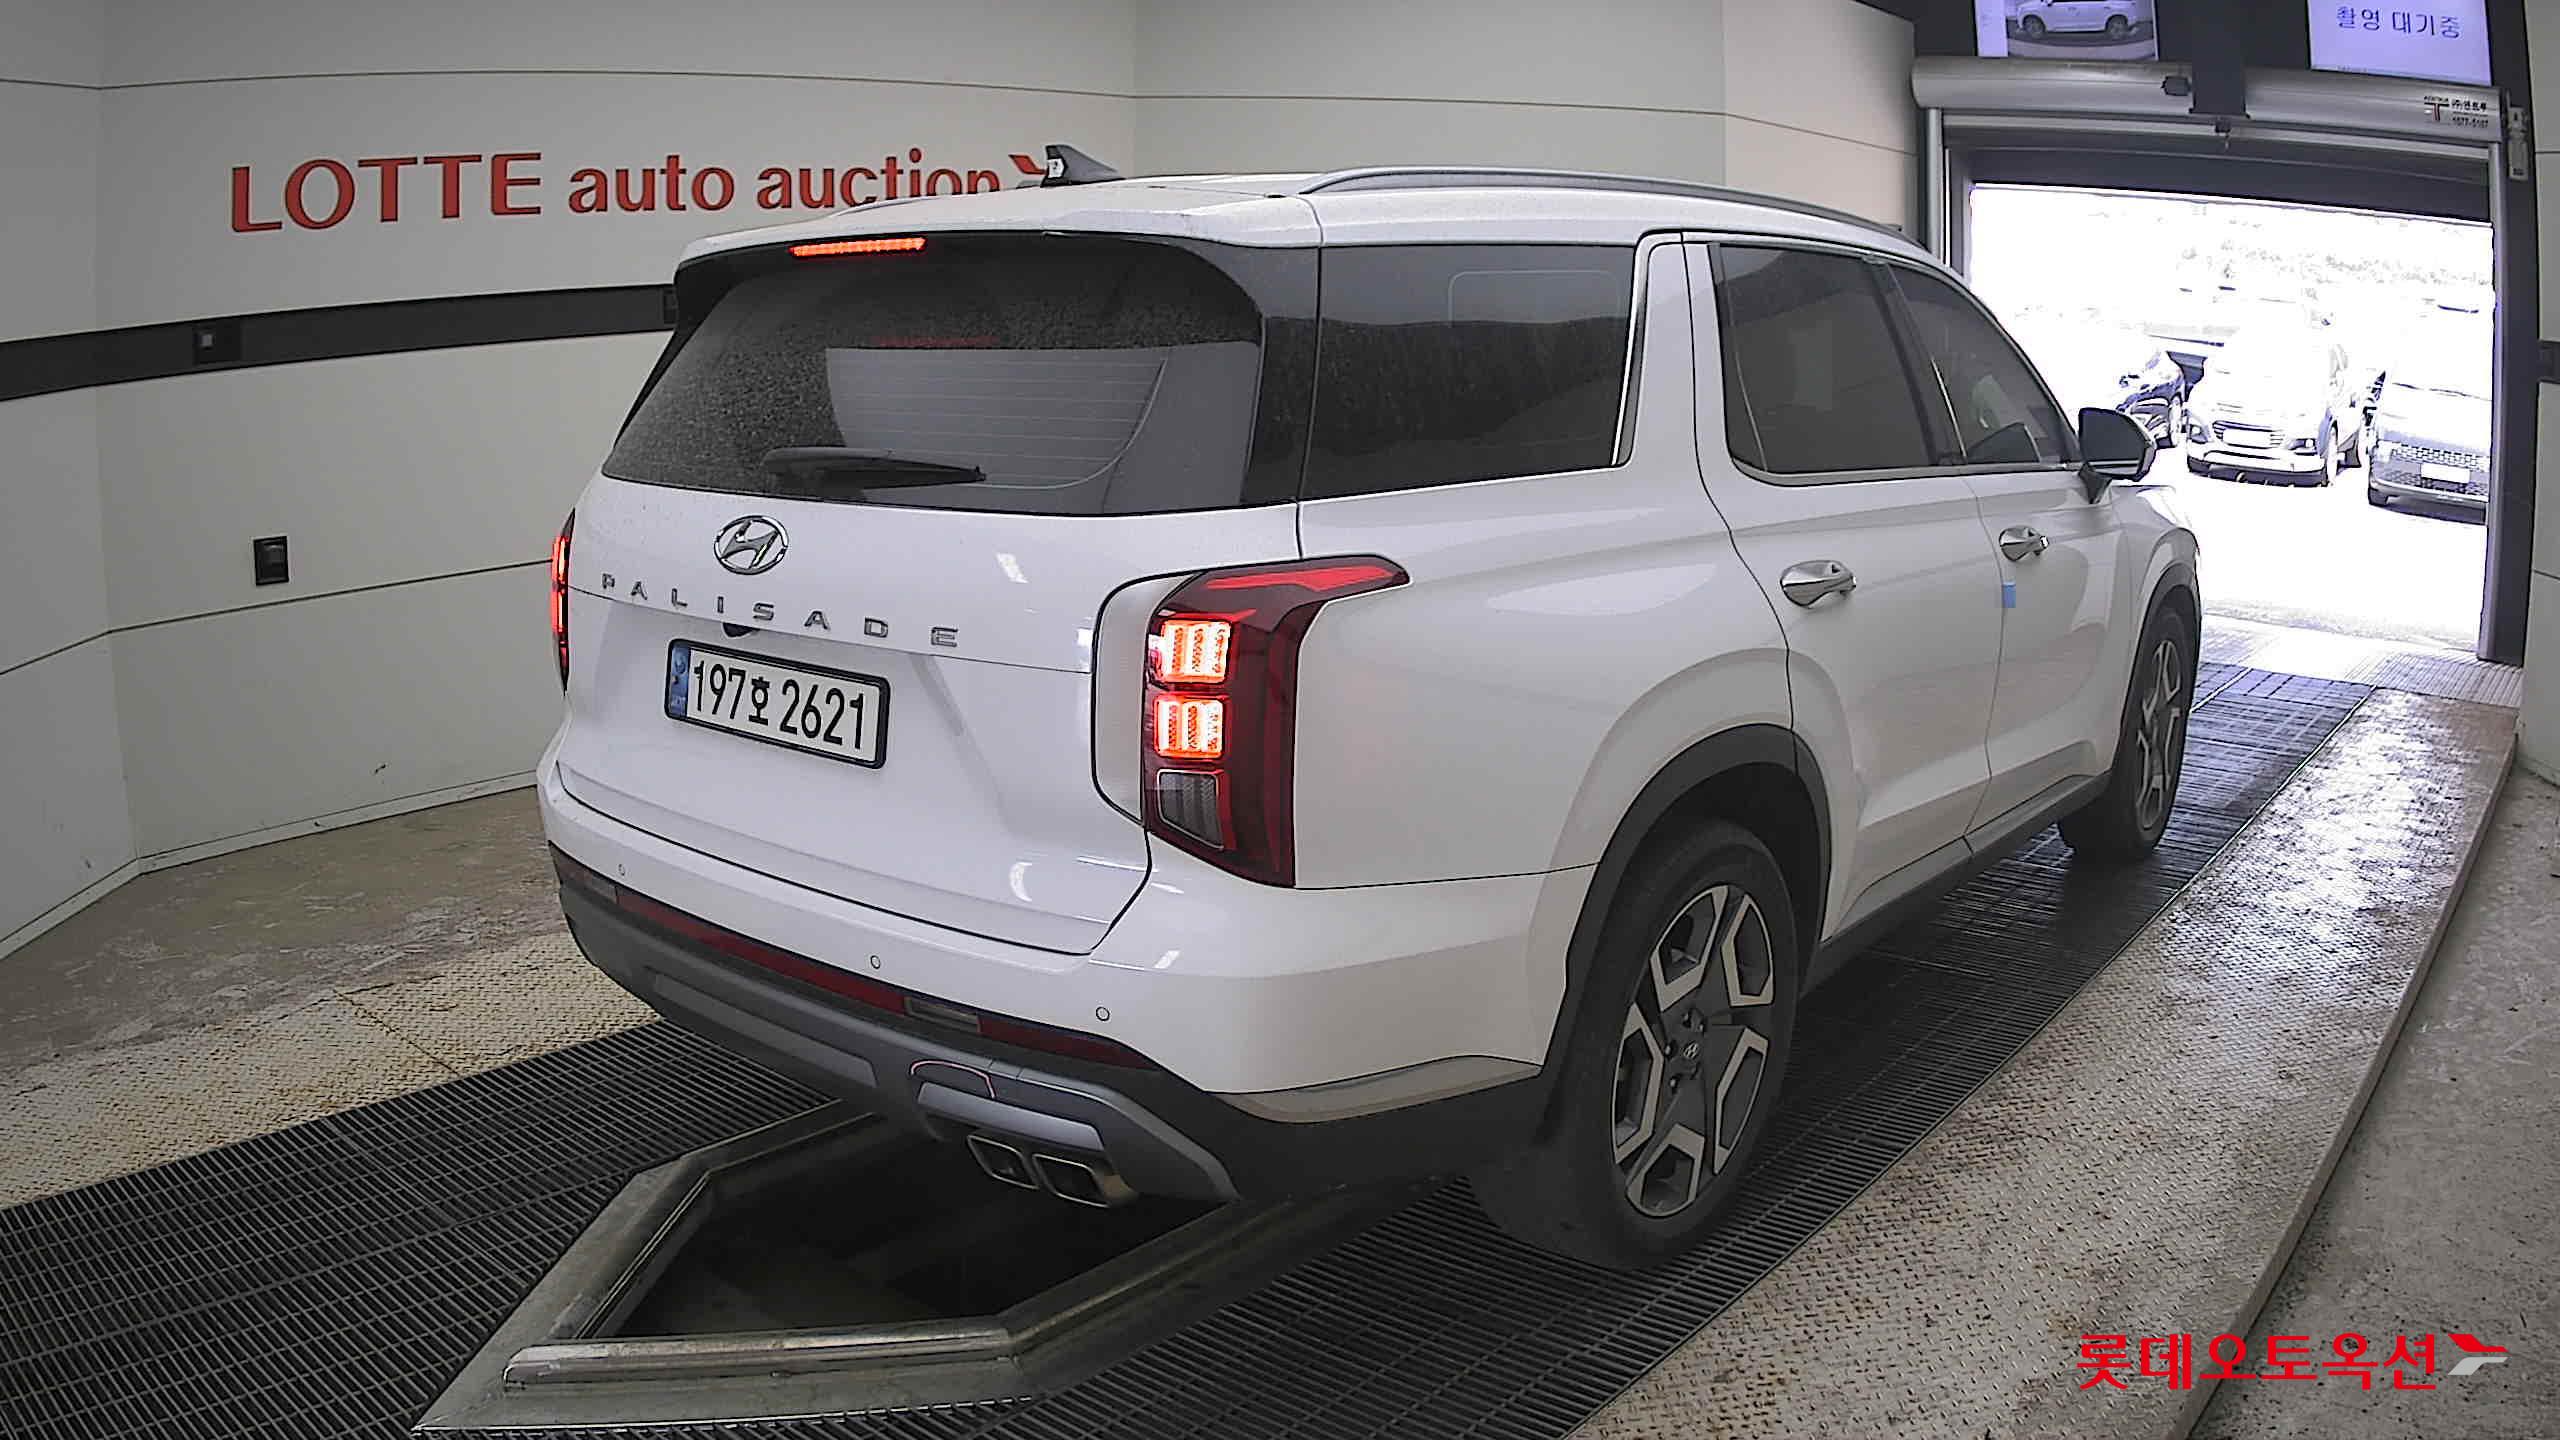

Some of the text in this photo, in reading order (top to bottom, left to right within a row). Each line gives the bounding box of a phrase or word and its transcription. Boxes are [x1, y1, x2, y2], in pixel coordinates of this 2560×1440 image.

[2392, 11, 2460, 38] 대기중
[231, 147, 1001, 233] LOTTE auto auction
[601, 572, 959, 648] PALISADE
[693, 660, 863, 750] 197호 2621
